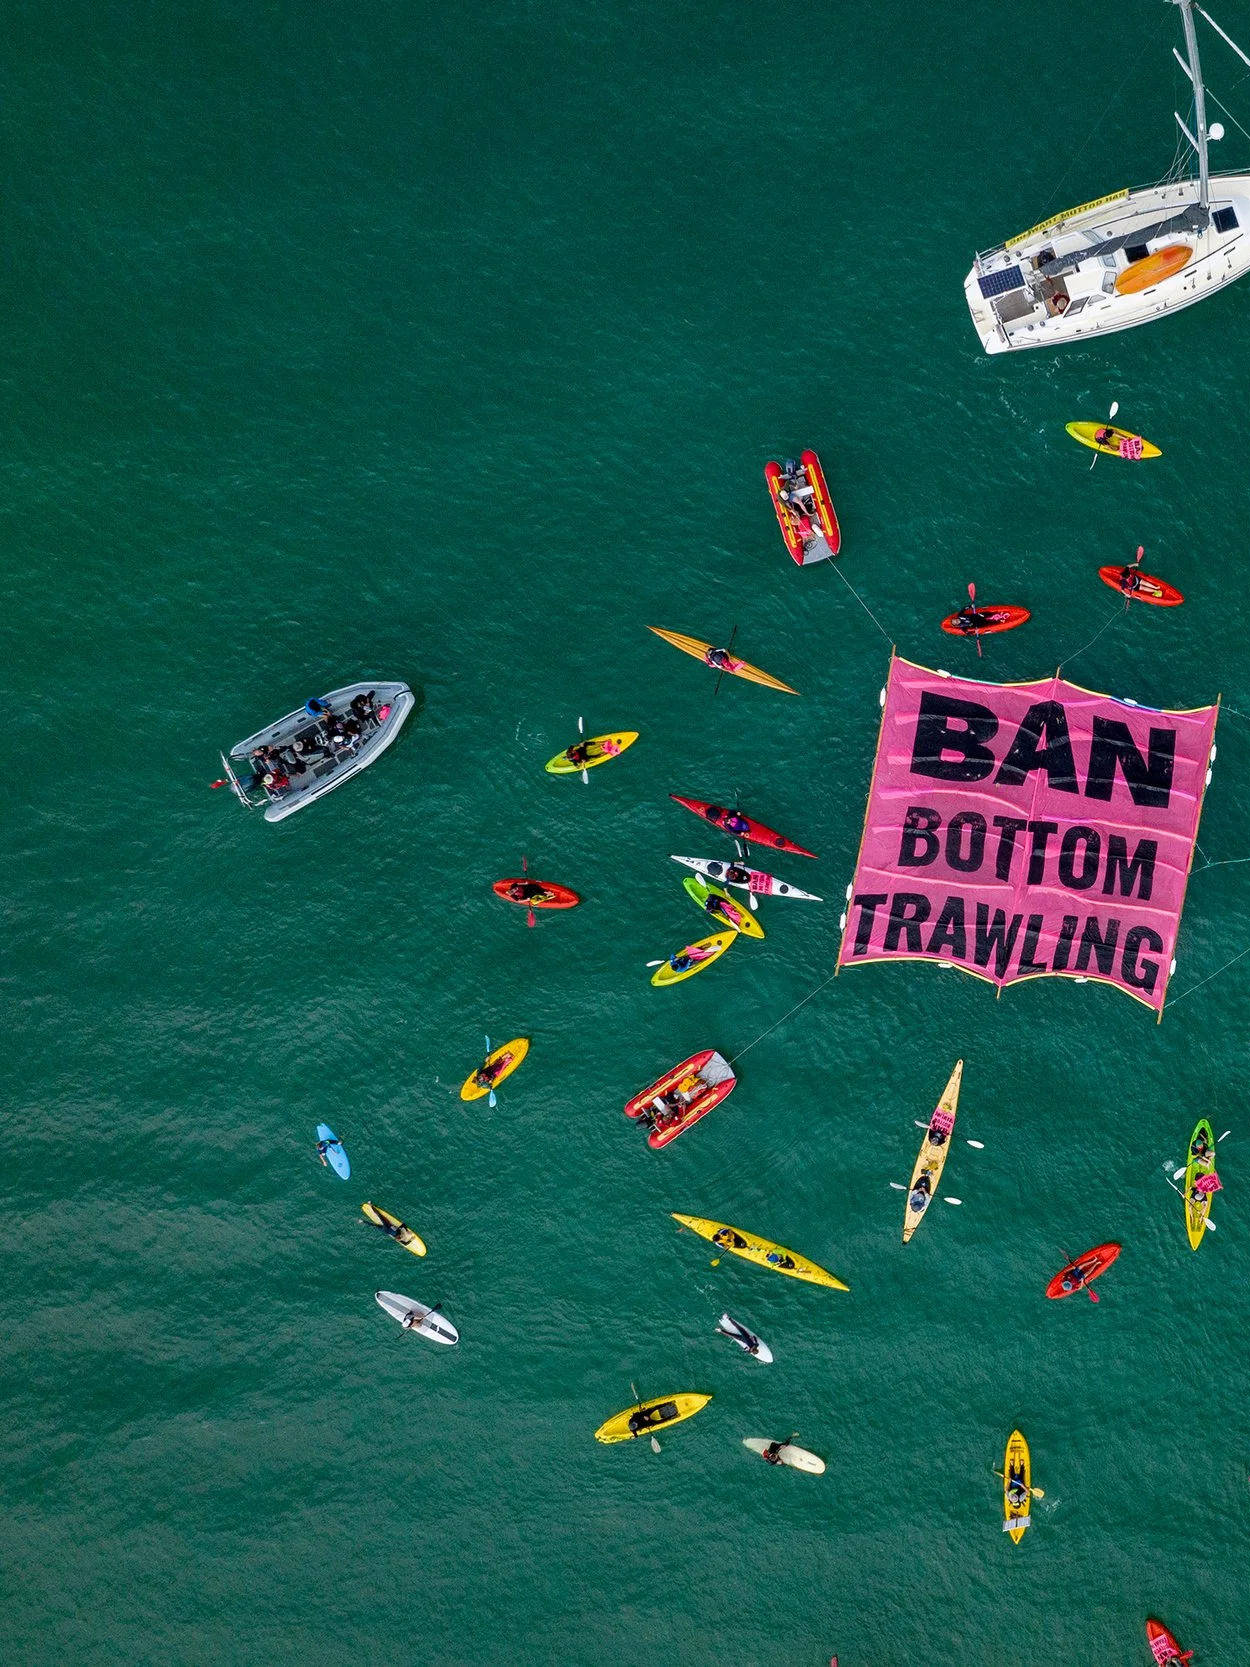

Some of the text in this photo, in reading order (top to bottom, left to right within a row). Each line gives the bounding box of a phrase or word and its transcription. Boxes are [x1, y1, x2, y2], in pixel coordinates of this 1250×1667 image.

[910, 691, 1176, 808] BAN
[897, 806, 1158, 901] BOTTOM
[852, 892, 1164, 995] TRAWLING
